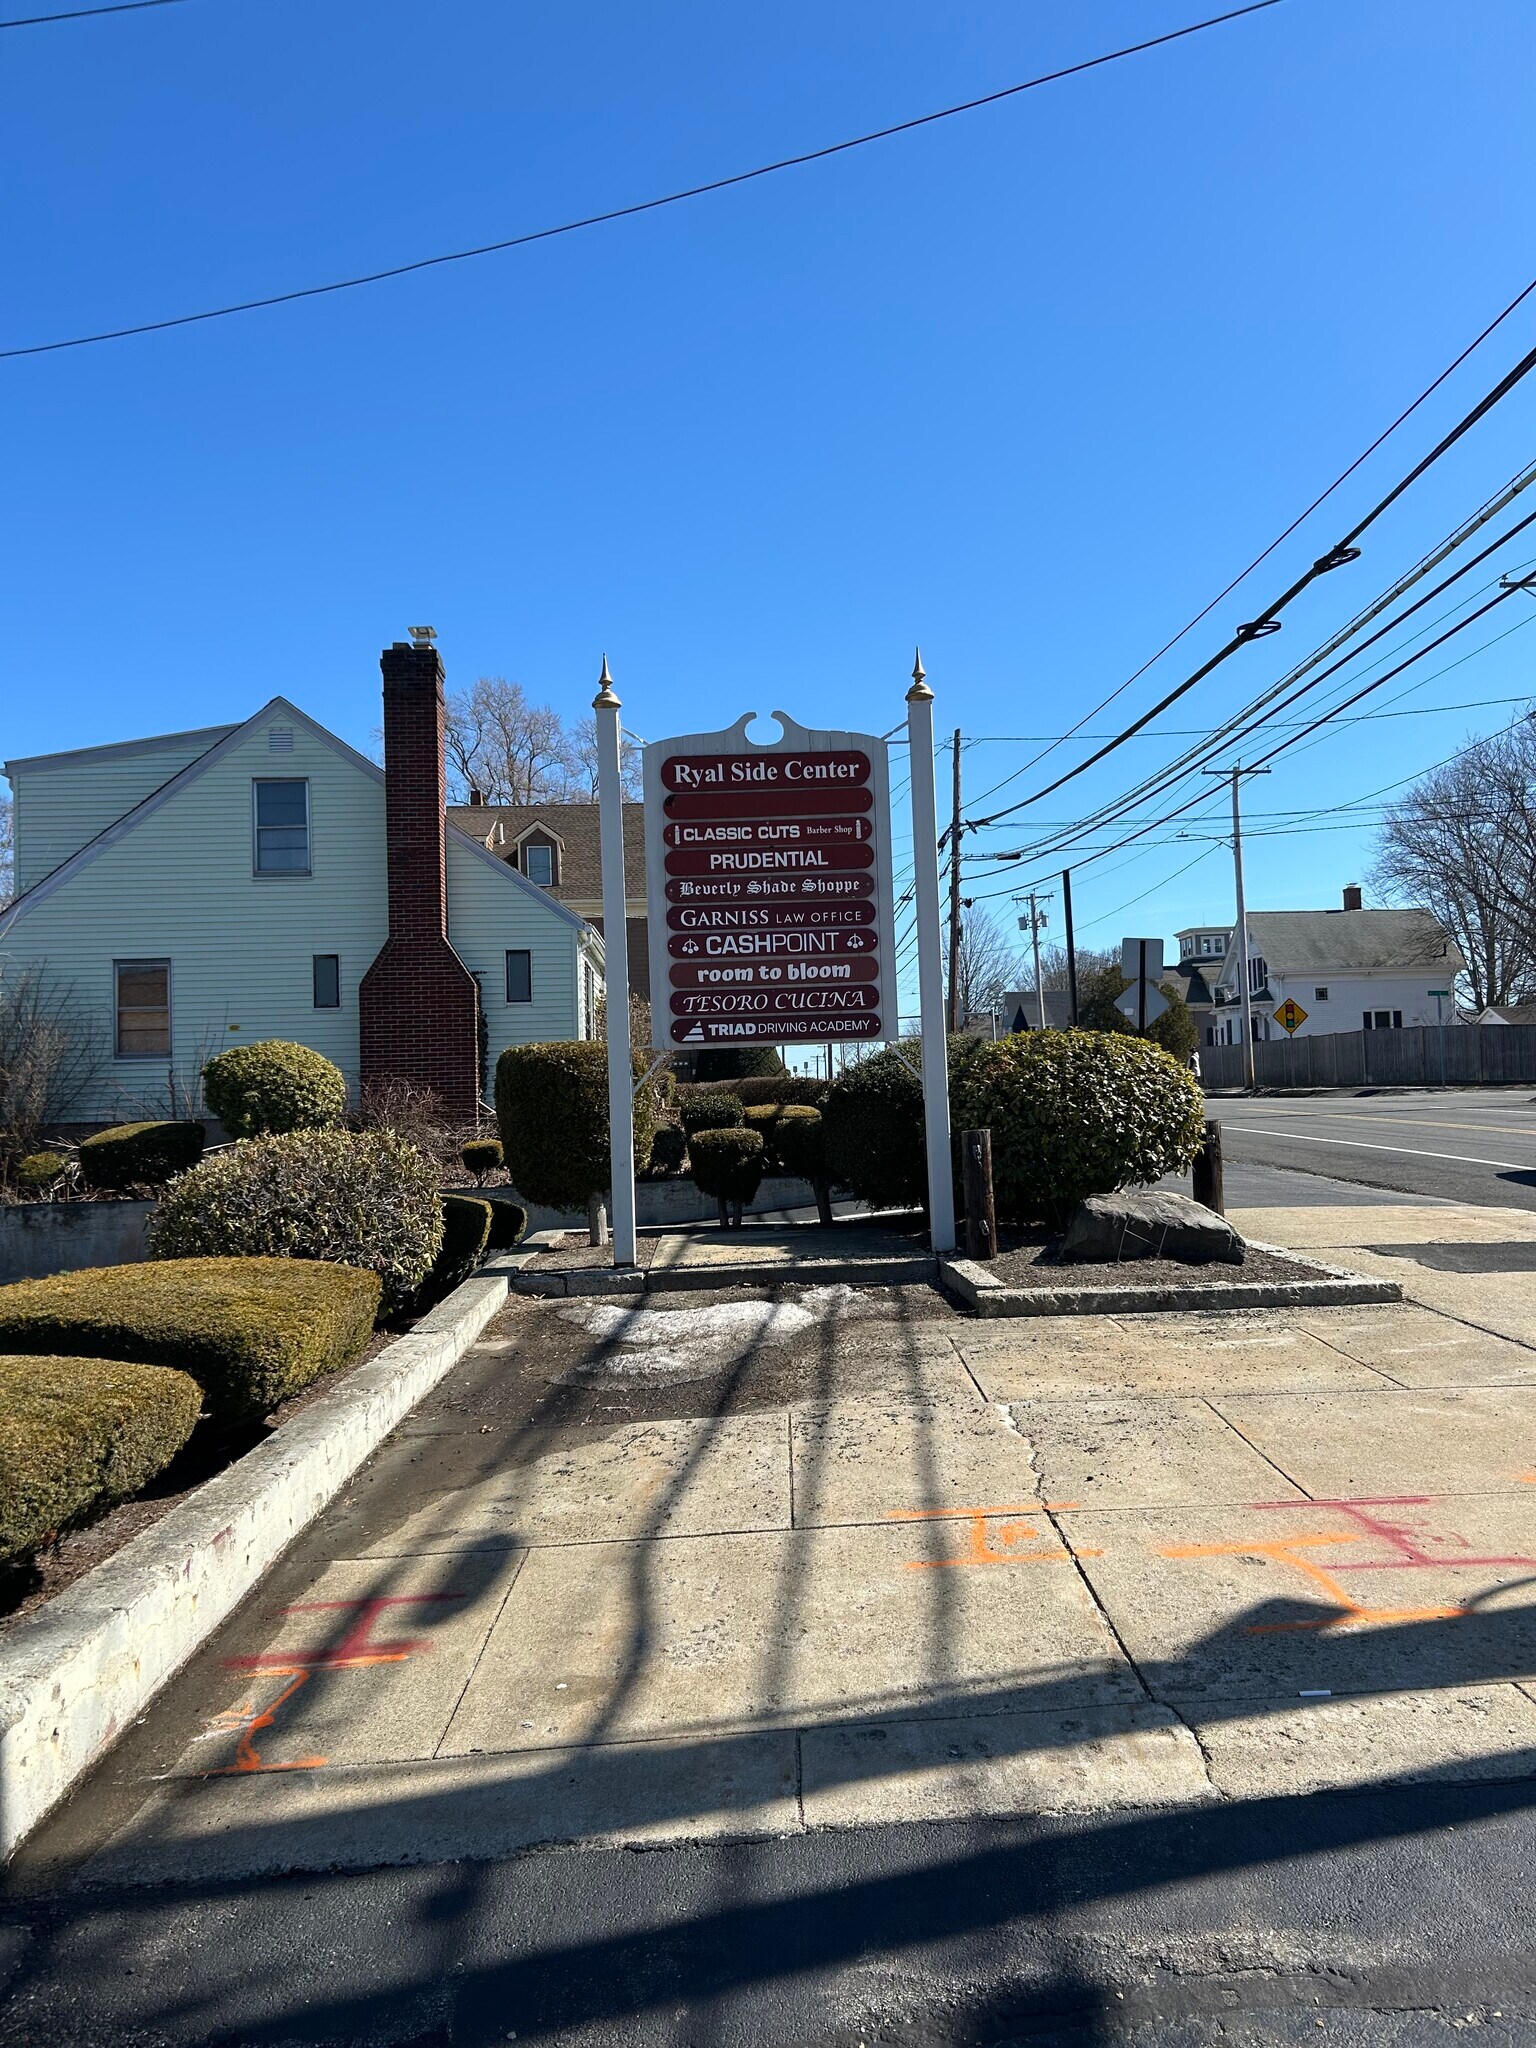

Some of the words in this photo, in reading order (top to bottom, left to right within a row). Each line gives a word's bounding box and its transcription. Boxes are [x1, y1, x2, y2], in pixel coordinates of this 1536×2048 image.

[674, 765, 724, 788] Ryal
[731, 761, 778, 782] Side
[784, 760, 859, 780] Center
[683, 827, 752, 841] CLASSIC
[758, 825, 800, 839] CUTS
[806, 826, 832, 835] Barber
[834, 824, 853, 835] Shop
[710, 850, 829, 869] PRUDENTIAL
[679, 881, 741, 898] Beverly
[746, 880, 797, 895] Shade
[801, 878, 860, 894] Shoppe
[680, 909, 769, 927] GARNISS
[776, 912, 805, 924] LAW
[810, 910, 862, 923] OFFICE
[705, 932, 840, 955] CASHPOINT
[697, 968, 753, 983] room
[759, 965, 782, 980] to
[787, 963, 851, 981] bloom
[683, 994, 768, 1013] TESORO
[774, 990, 866, 1010] CUCINA
[708, 1024, 757, 1036] TRIAD
[758, 1021, 807, 1034] DRIVING
[809, 1019, 871, 1033] ACADEMY
